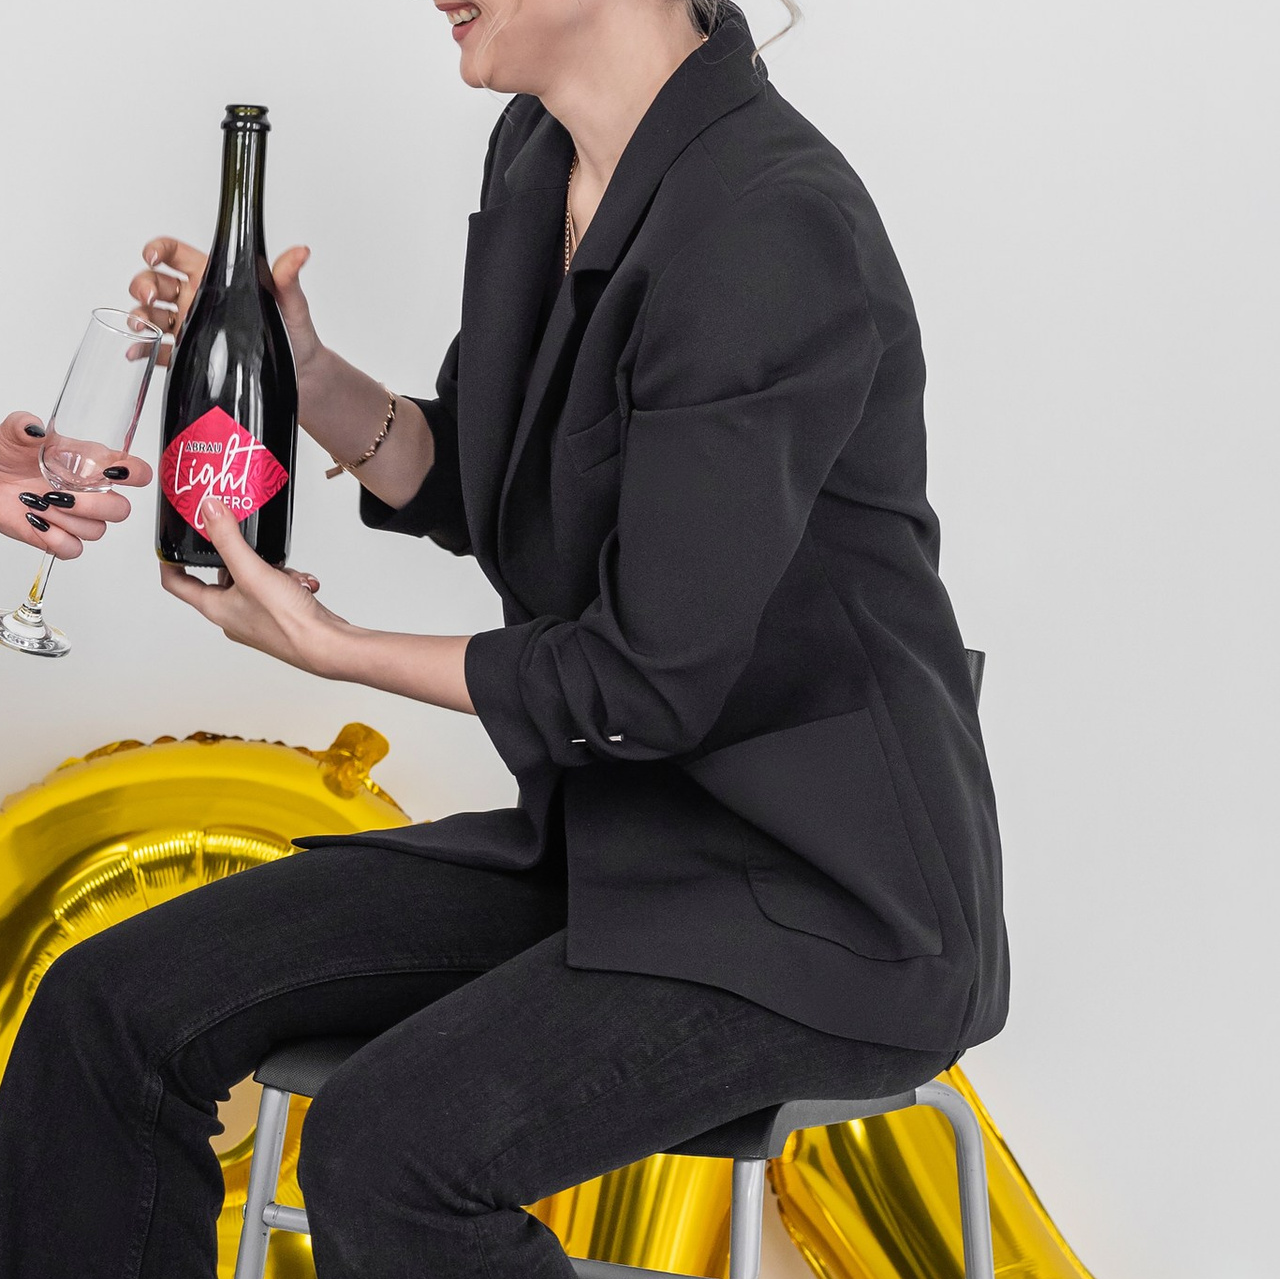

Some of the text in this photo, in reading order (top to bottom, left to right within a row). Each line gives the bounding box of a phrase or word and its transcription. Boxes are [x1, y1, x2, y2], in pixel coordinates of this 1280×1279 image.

[185, 440, 223, 454] ABRAU
[174, 433, 267, 530] Light
[213, 495, 253, 510] ERO
